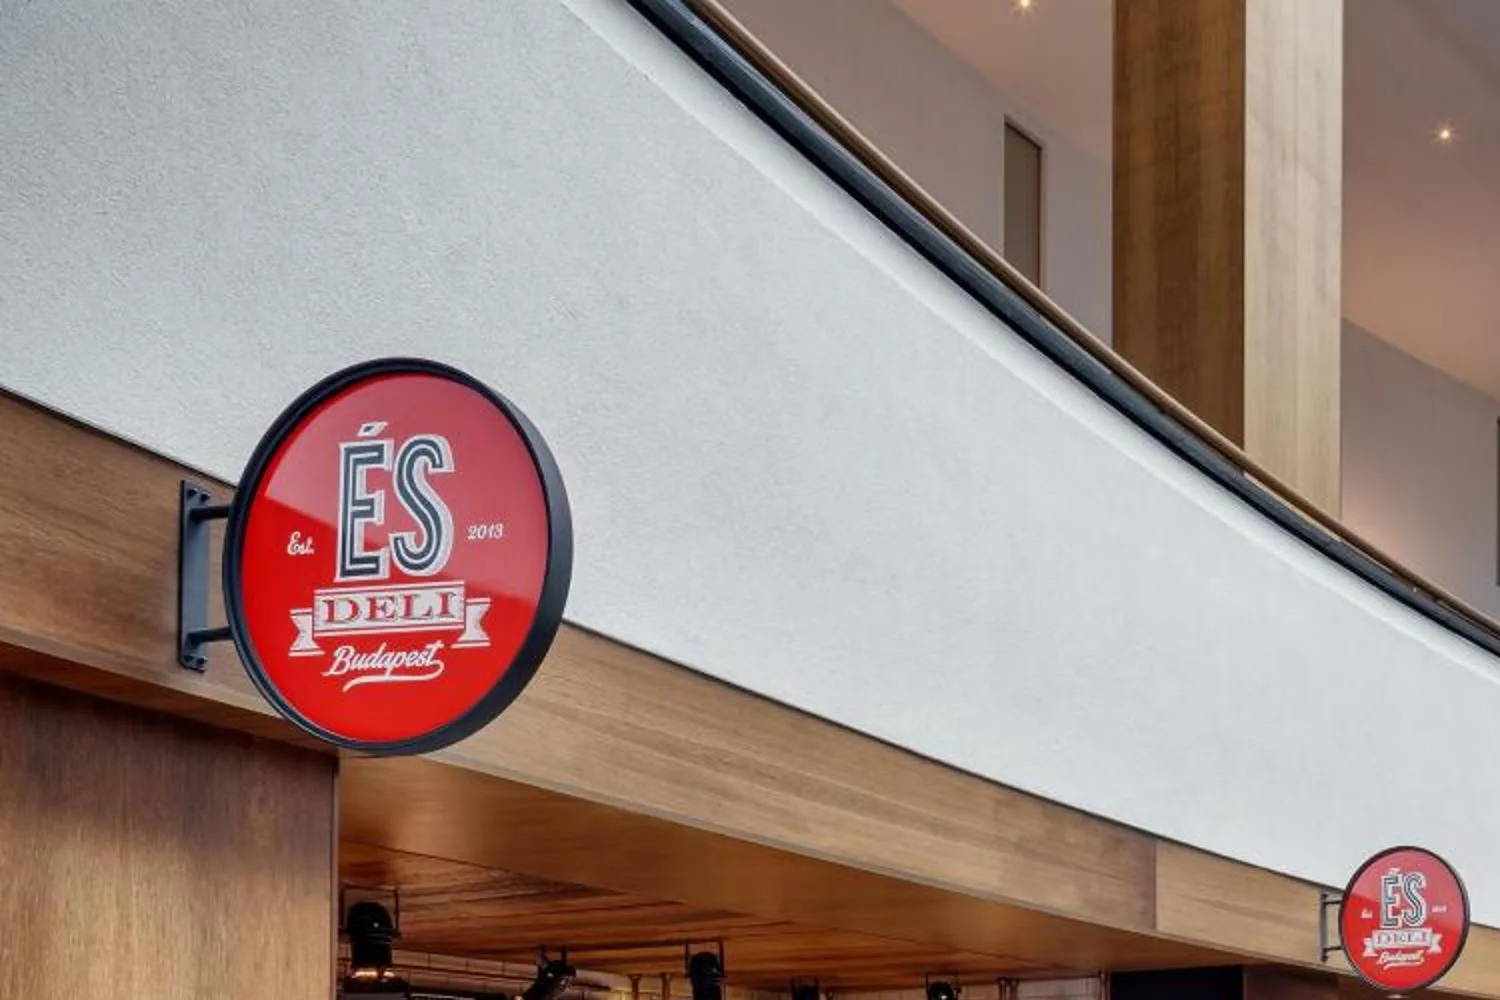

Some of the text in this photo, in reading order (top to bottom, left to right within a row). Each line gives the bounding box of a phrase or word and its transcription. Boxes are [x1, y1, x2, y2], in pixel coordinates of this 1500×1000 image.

[334, 421, 455, 583] ÉS
[287, 531, 315, 557] Est.
[466, 523, 504, 542] 2013
[320, 591, 457, 625] DELI
[322, 641, 446, 692] Budapest
[1380, 867, 1427, 928] ÉS
